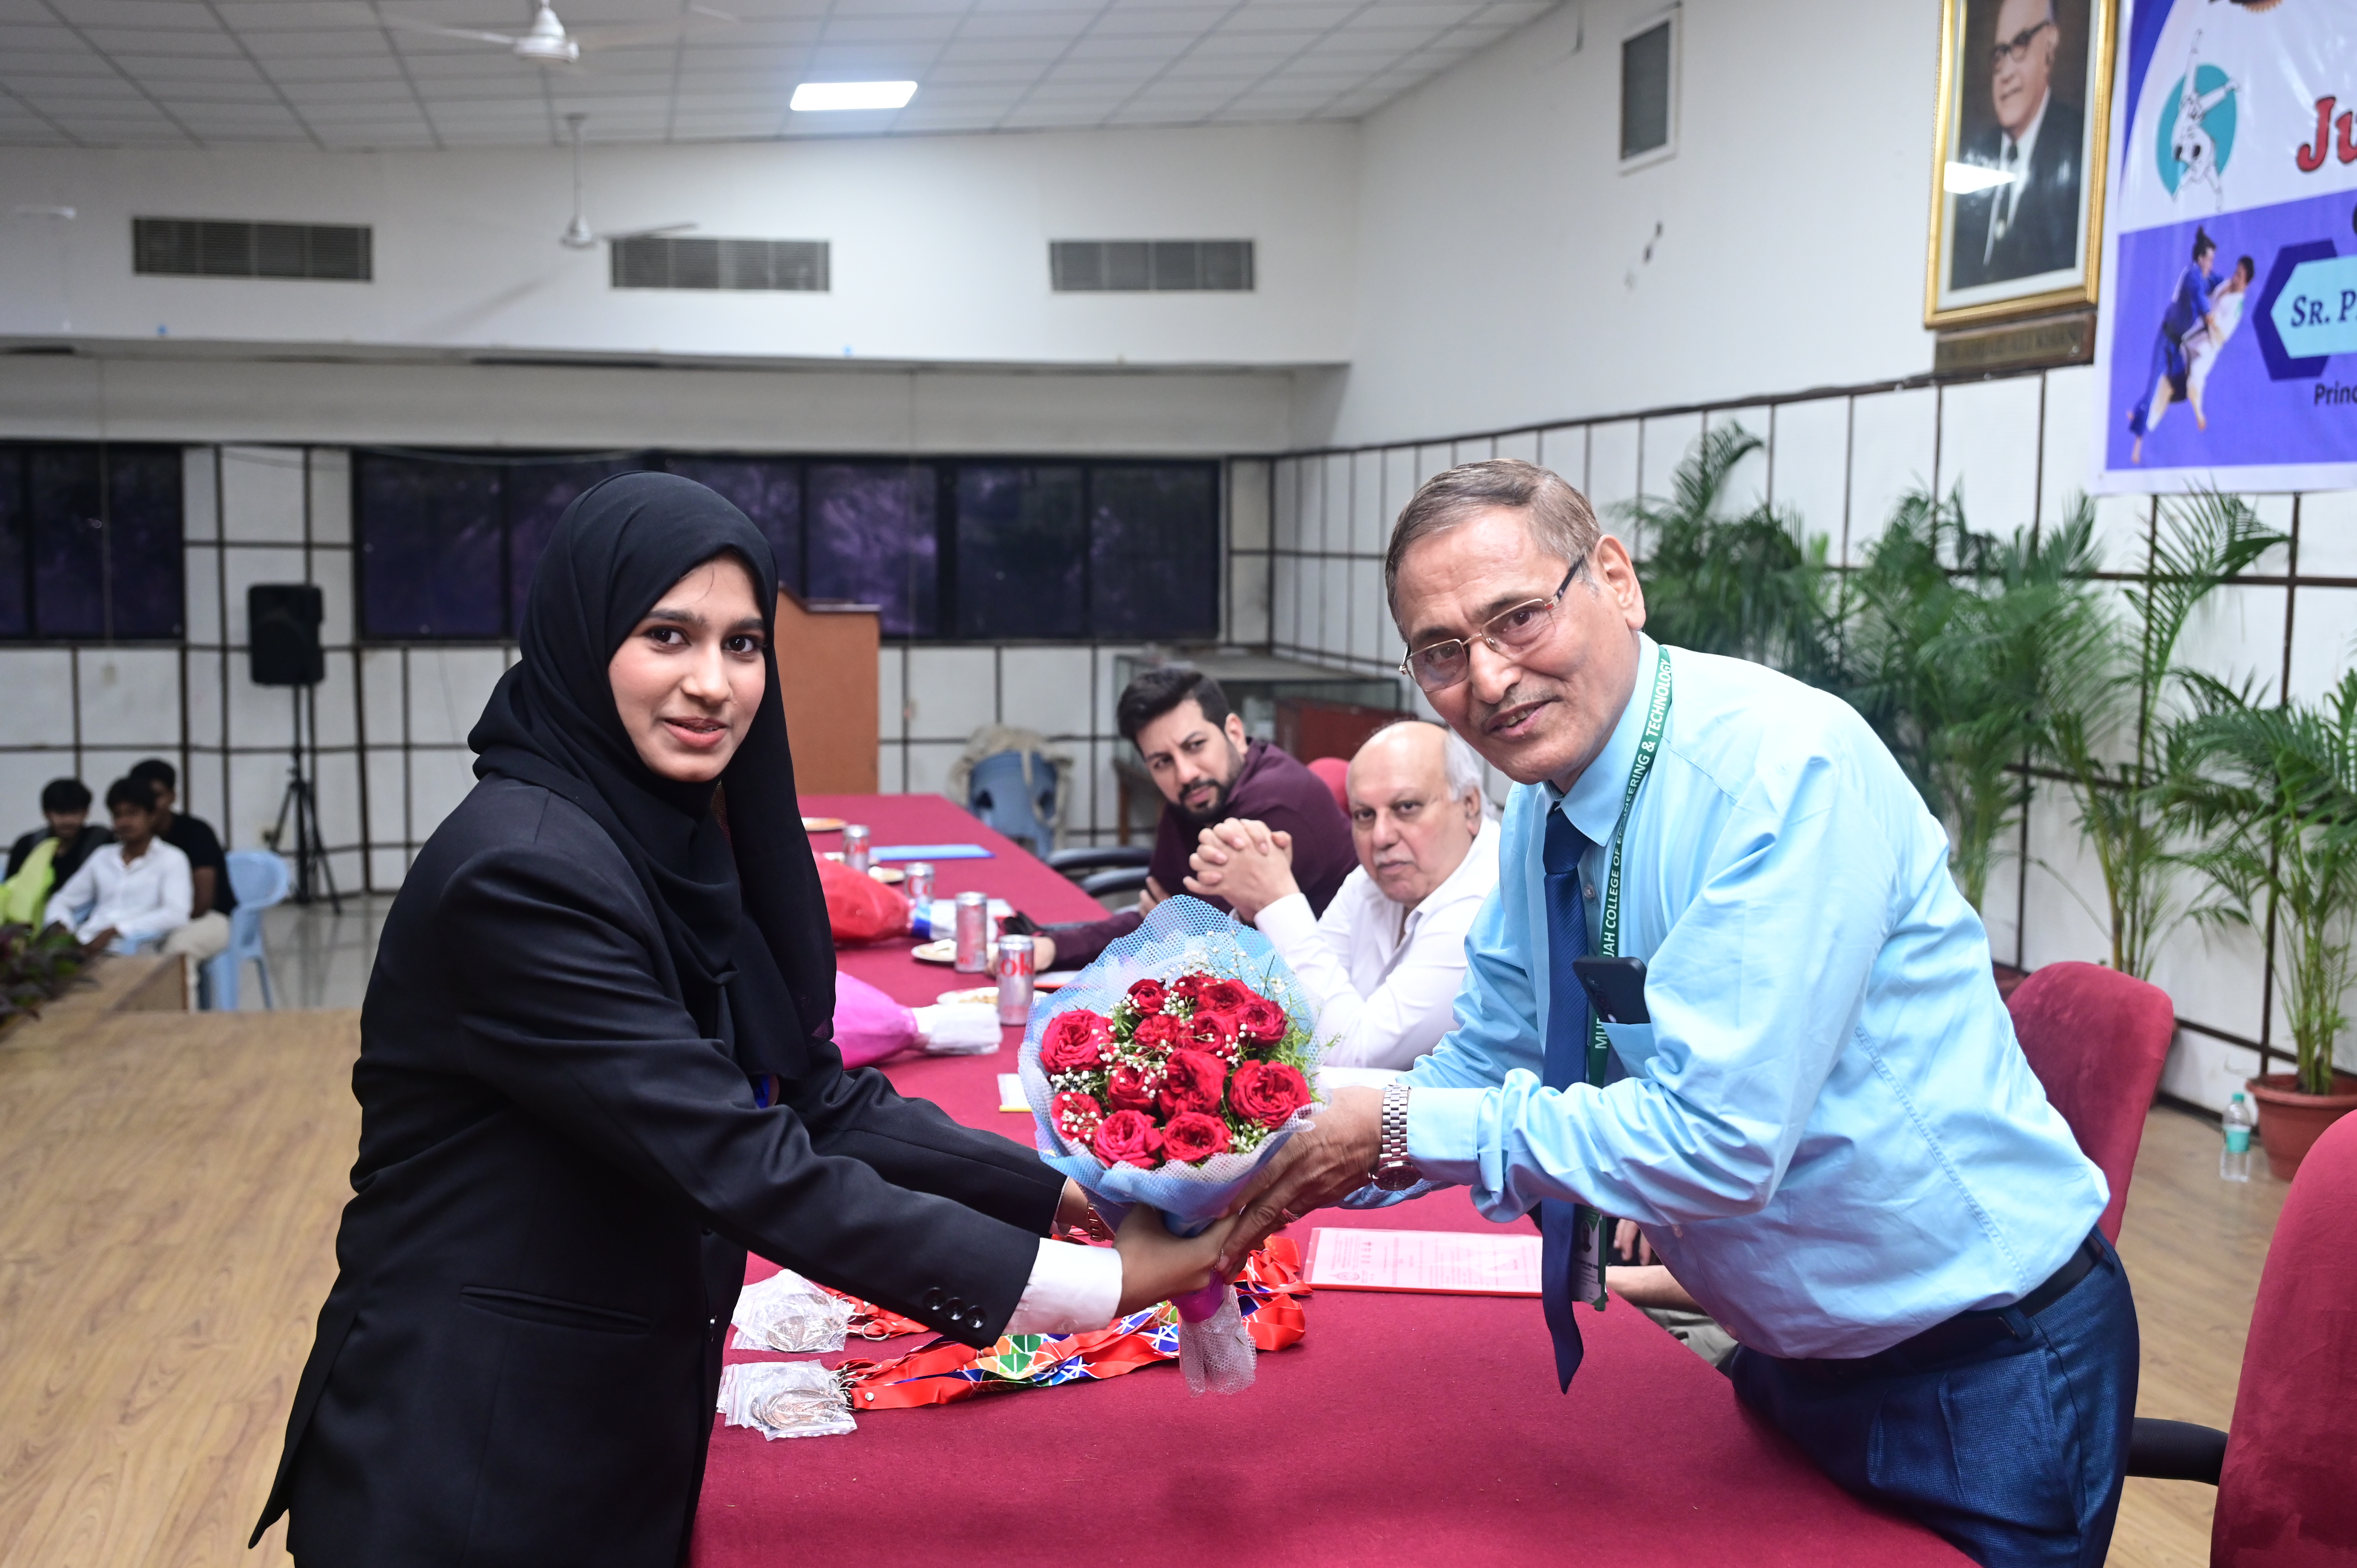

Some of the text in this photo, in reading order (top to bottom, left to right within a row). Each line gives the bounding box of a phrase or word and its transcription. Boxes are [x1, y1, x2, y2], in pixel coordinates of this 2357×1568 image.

[2338, 290, 2357, 321] P
[1645, 658, 1671, 736] TECHNOLOGY
[1641, 741, 1656, 752] &
[1613, 848, 1620, 866] OF
[1605, 869, 1619, 929] COLLEGE
[1603, 932, 1615, 957] JAH
